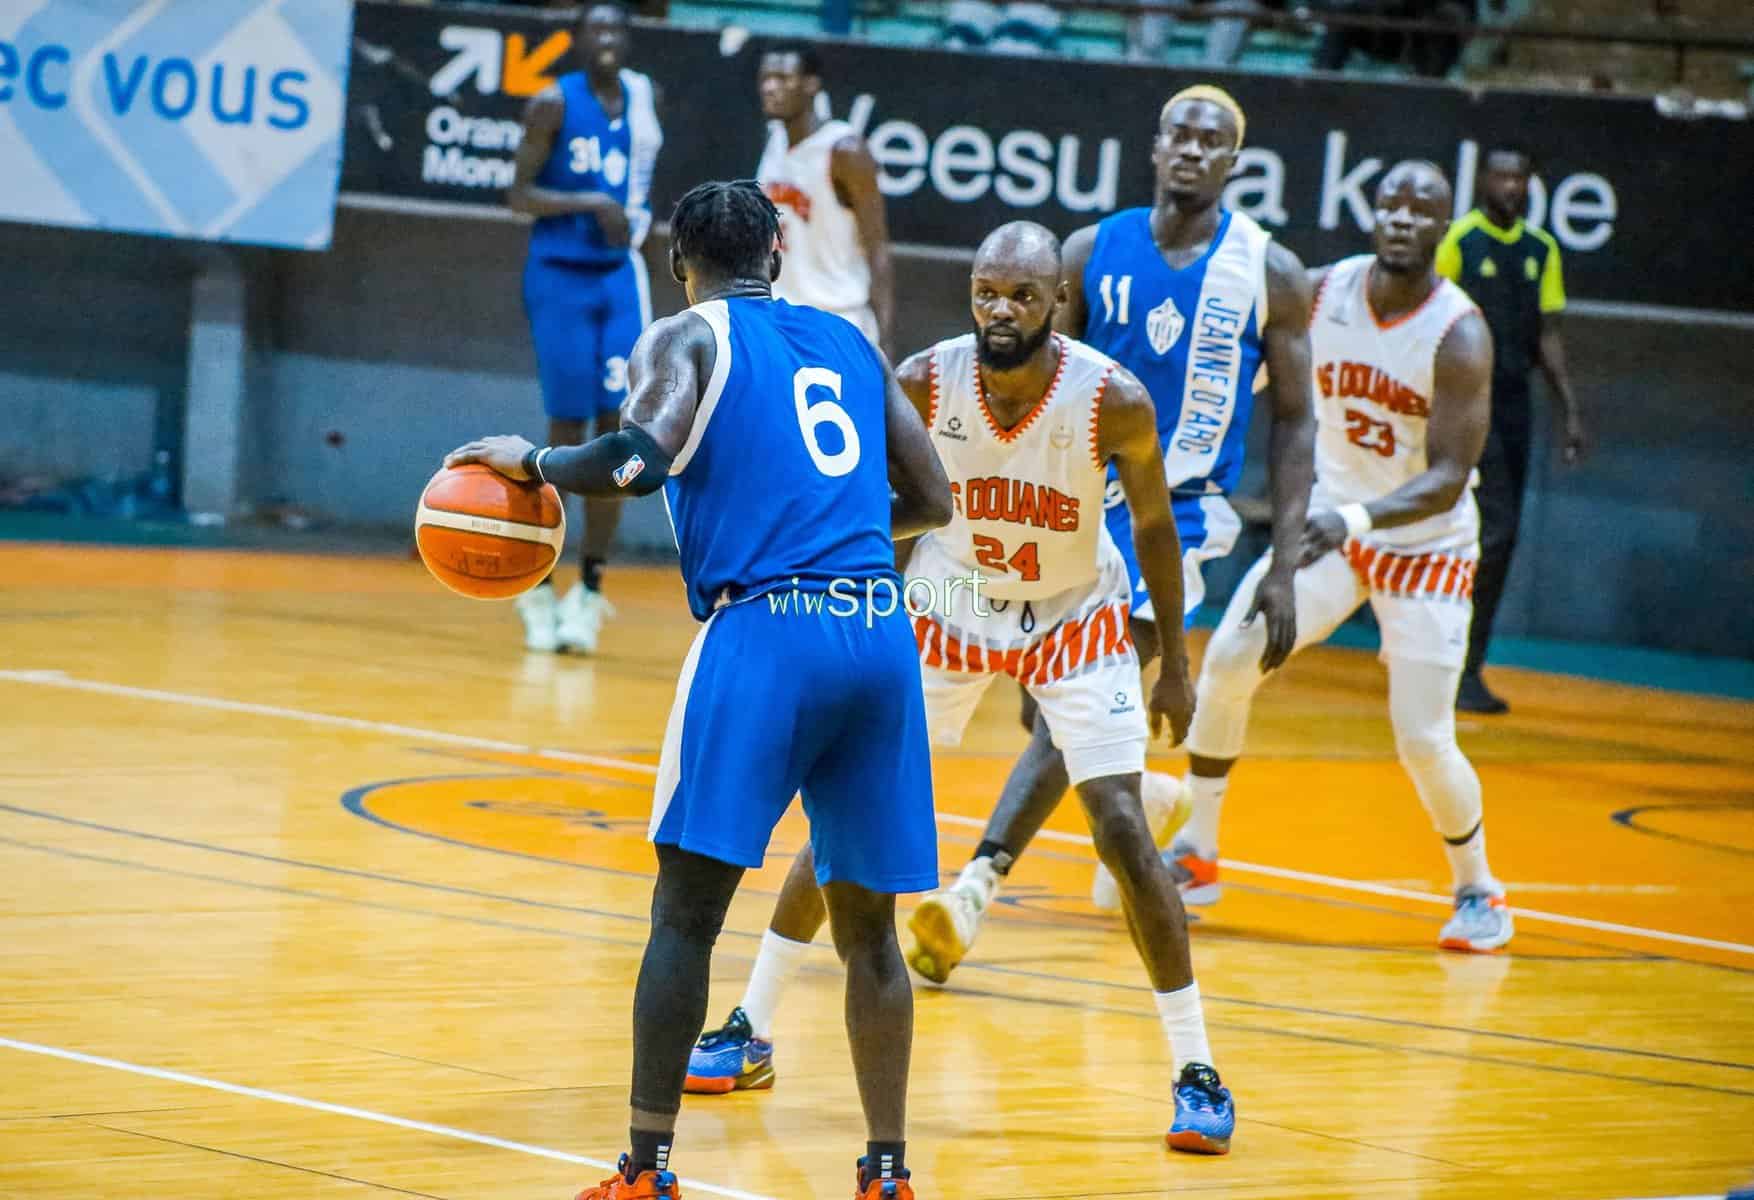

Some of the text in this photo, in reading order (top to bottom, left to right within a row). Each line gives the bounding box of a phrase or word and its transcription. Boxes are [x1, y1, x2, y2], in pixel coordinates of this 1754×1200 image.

[103, 52, 312, 131] vous
[426, 106, 526, 151] Oran
[423, 145, 516, 188] Mon
[1320, 130, 1618, 252] kle
[1099, 274, 1133, 325] 11
[1193, 297, 1241, 385] JEANNE
[793, 366, 861, 477] 6
[1345, 409, 1395, 458] 23
[966, 476, 1080, 532] DOUANES
[972, 533, 1040, 581] 24
